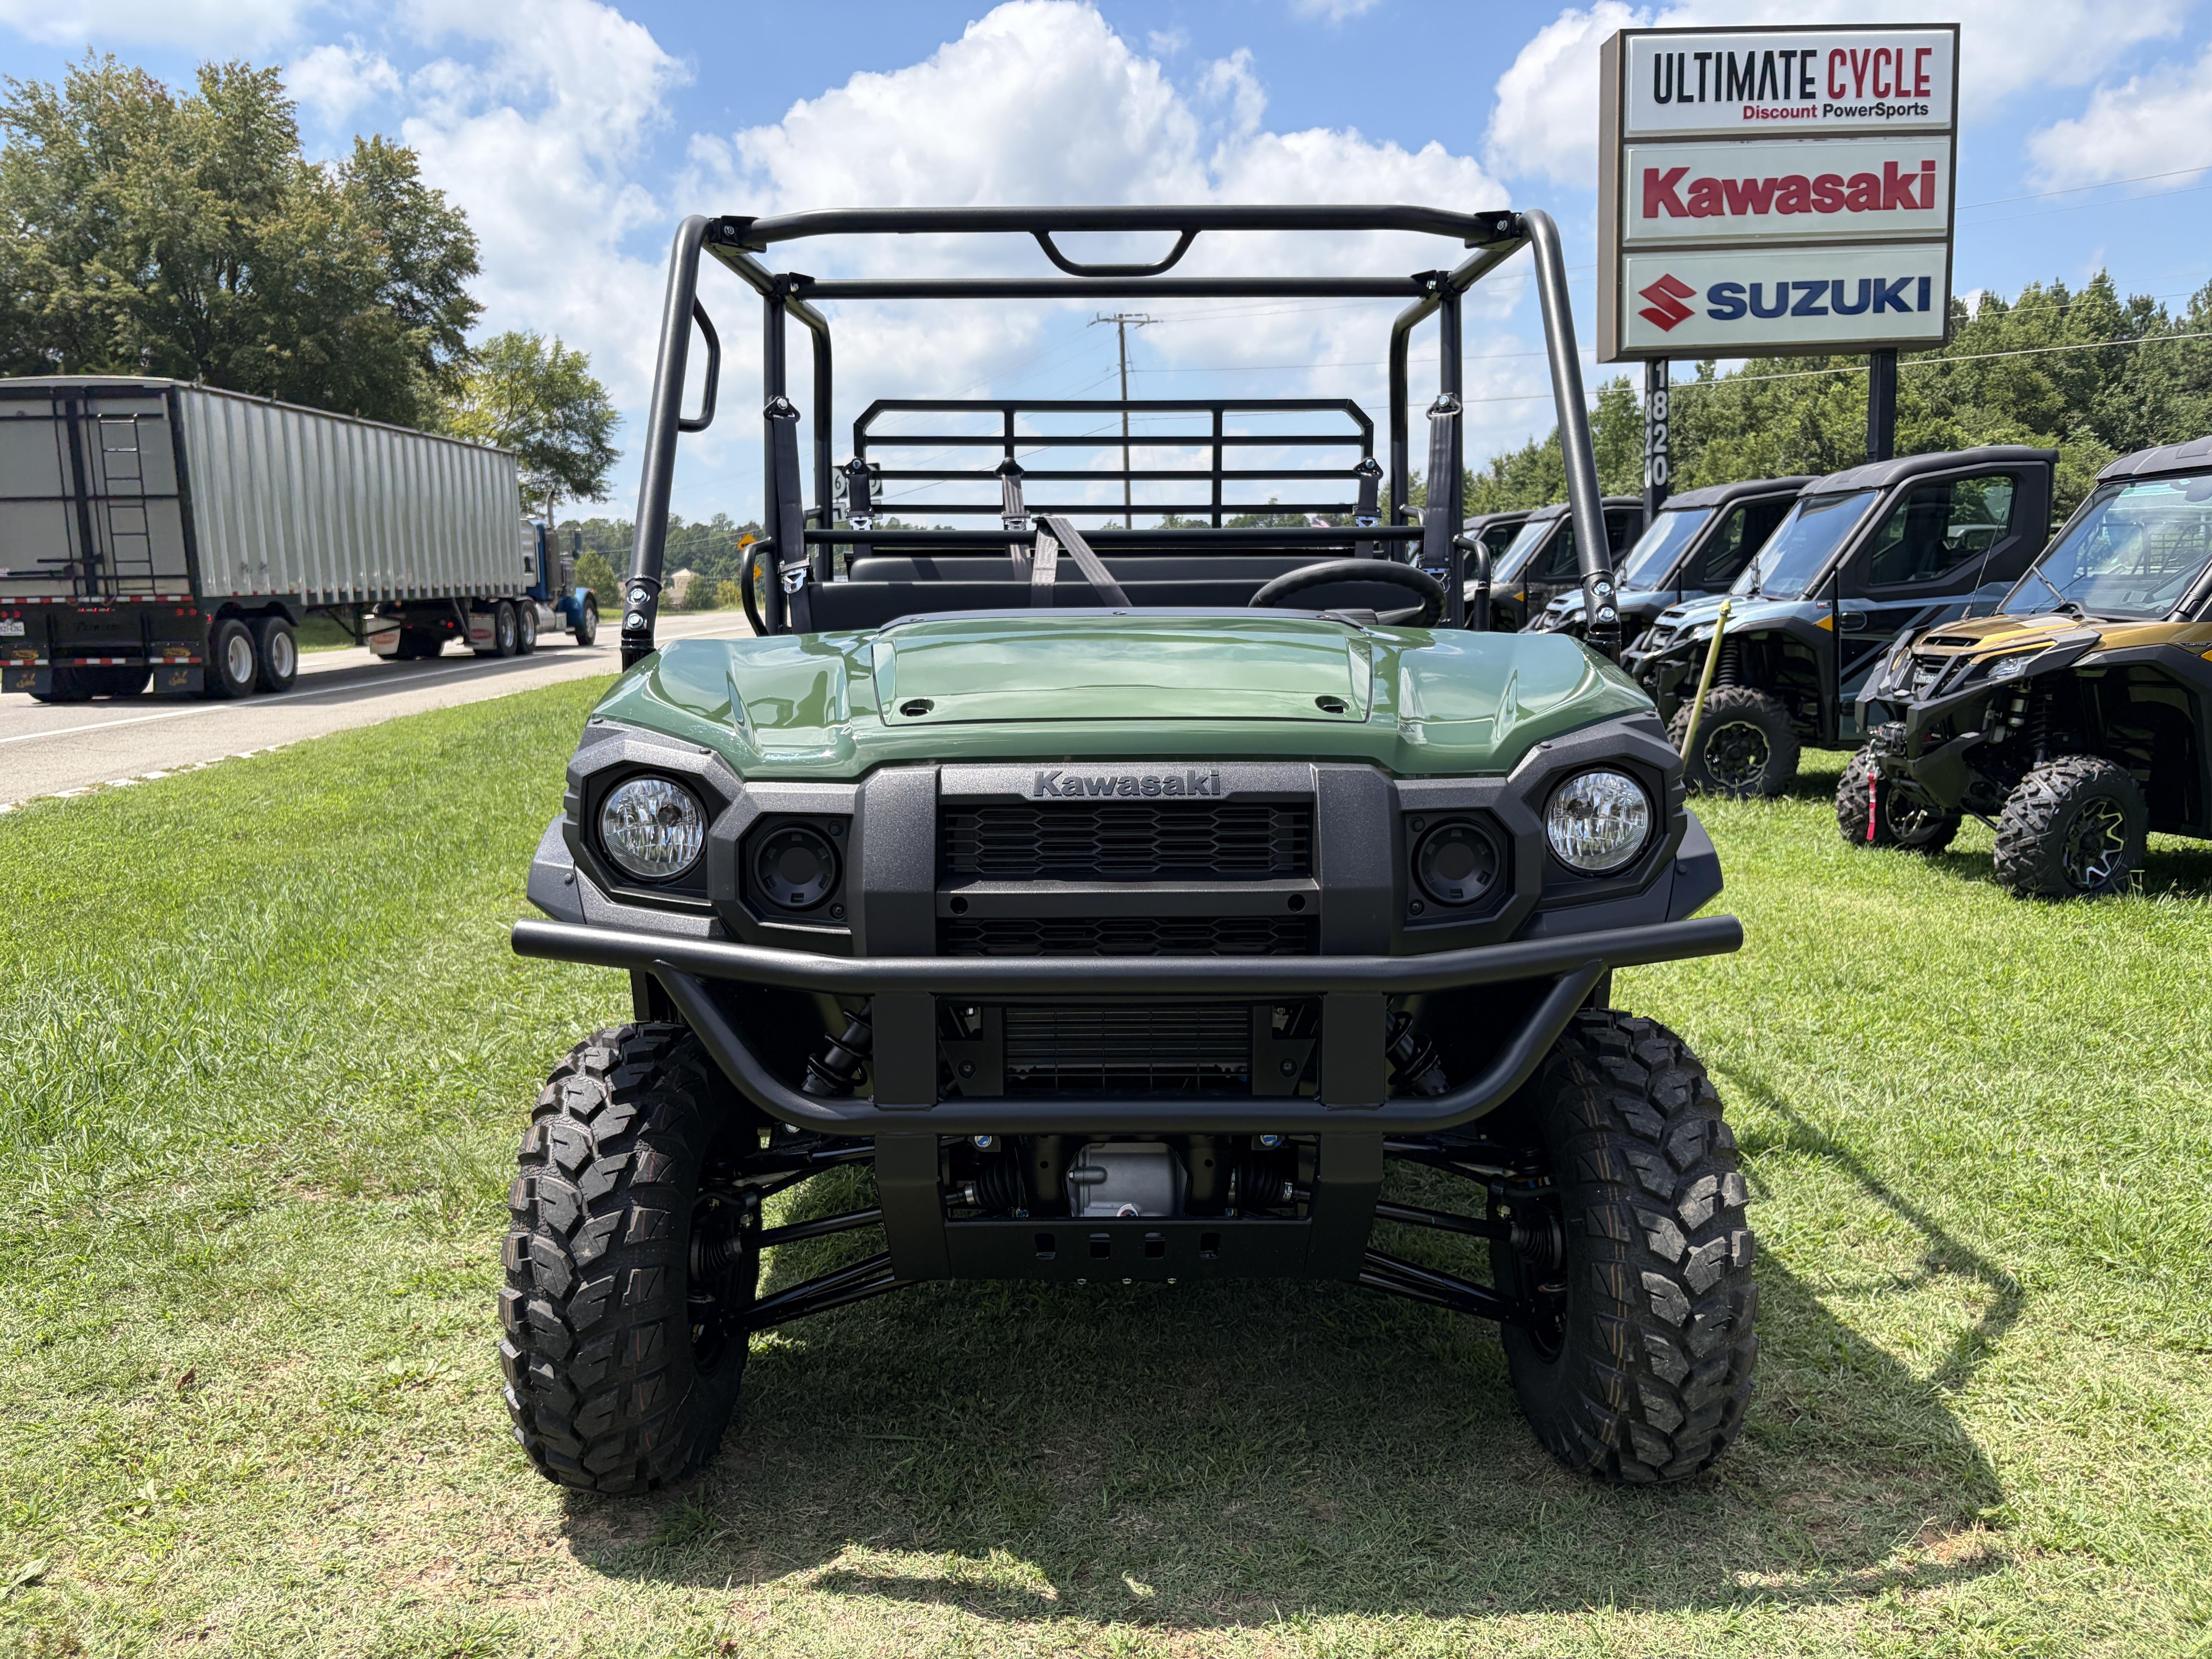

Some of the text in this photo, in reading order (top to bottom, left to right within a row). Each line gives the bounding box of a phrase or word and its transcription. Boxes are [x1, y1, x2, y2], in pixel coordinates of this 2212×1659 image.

[1654, 48, 1932, 104] ULTIMATE CYCLE
[1743, 102, 1929, 119] Discount PowerSports
[1643, 160, 1936, 218] Kawasaki
[1707, 276, 1931, 320] SUZUKI
[1653, 359, 1667, 486] 1820
[1034, 770, 1220, 796] Kawasaki
